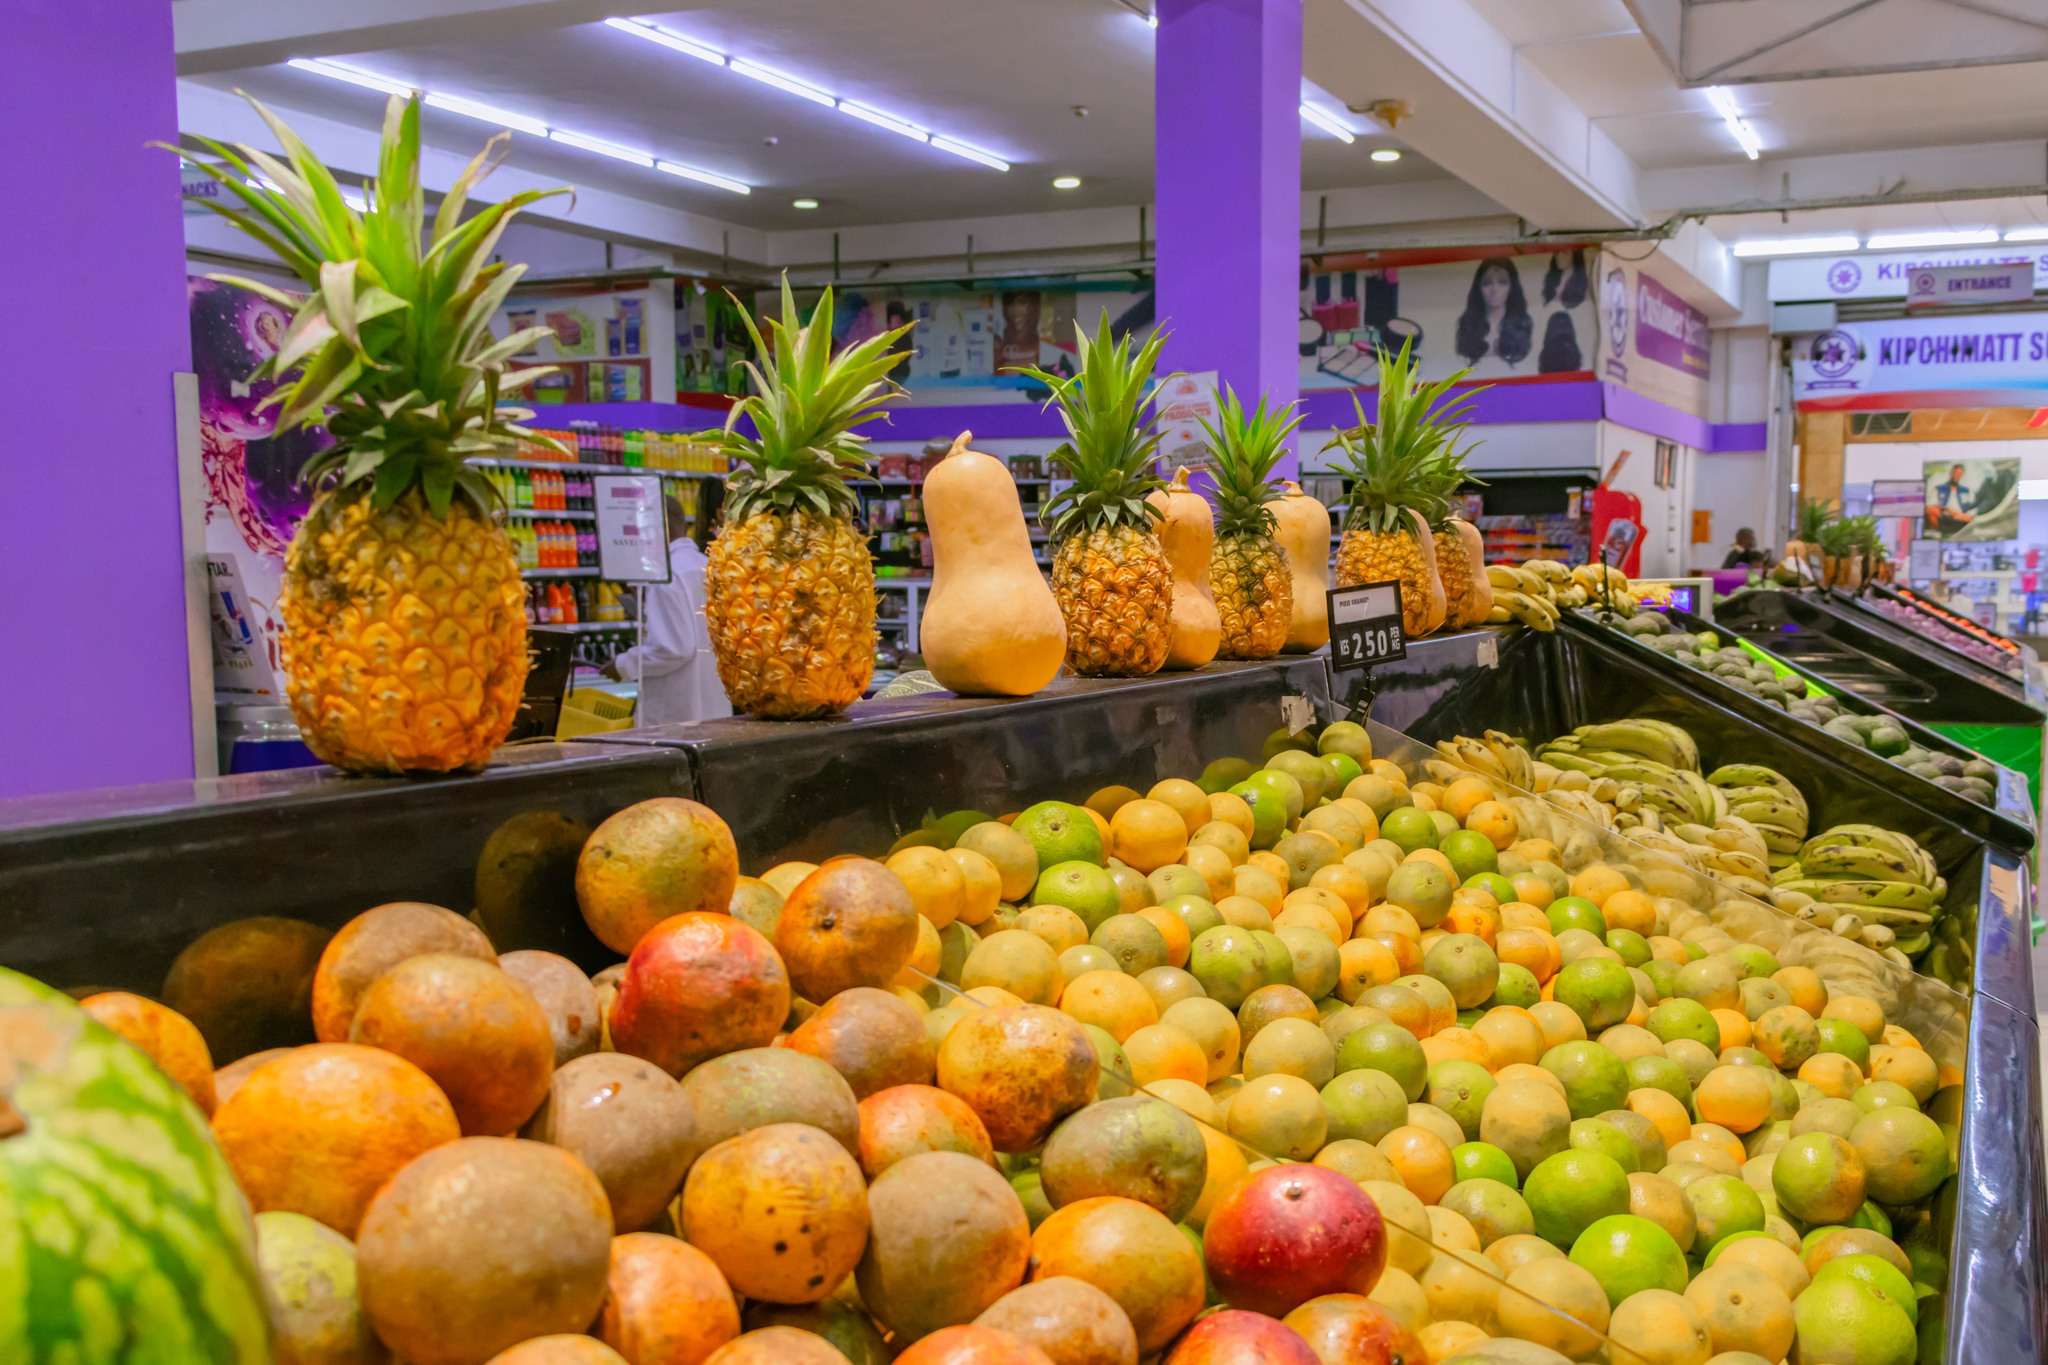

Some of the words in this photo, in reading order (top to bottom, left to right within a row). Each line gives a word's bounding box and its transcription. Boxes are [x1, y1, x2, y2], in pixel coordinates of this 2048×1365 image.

[1947, 275, 2012, 291] ENTRANCE
[1879, 333, 2024, 366] KIPCHIMATT
[1390, 626, 1400, 638] PER
[1352, 630, 1388, 659] 250
